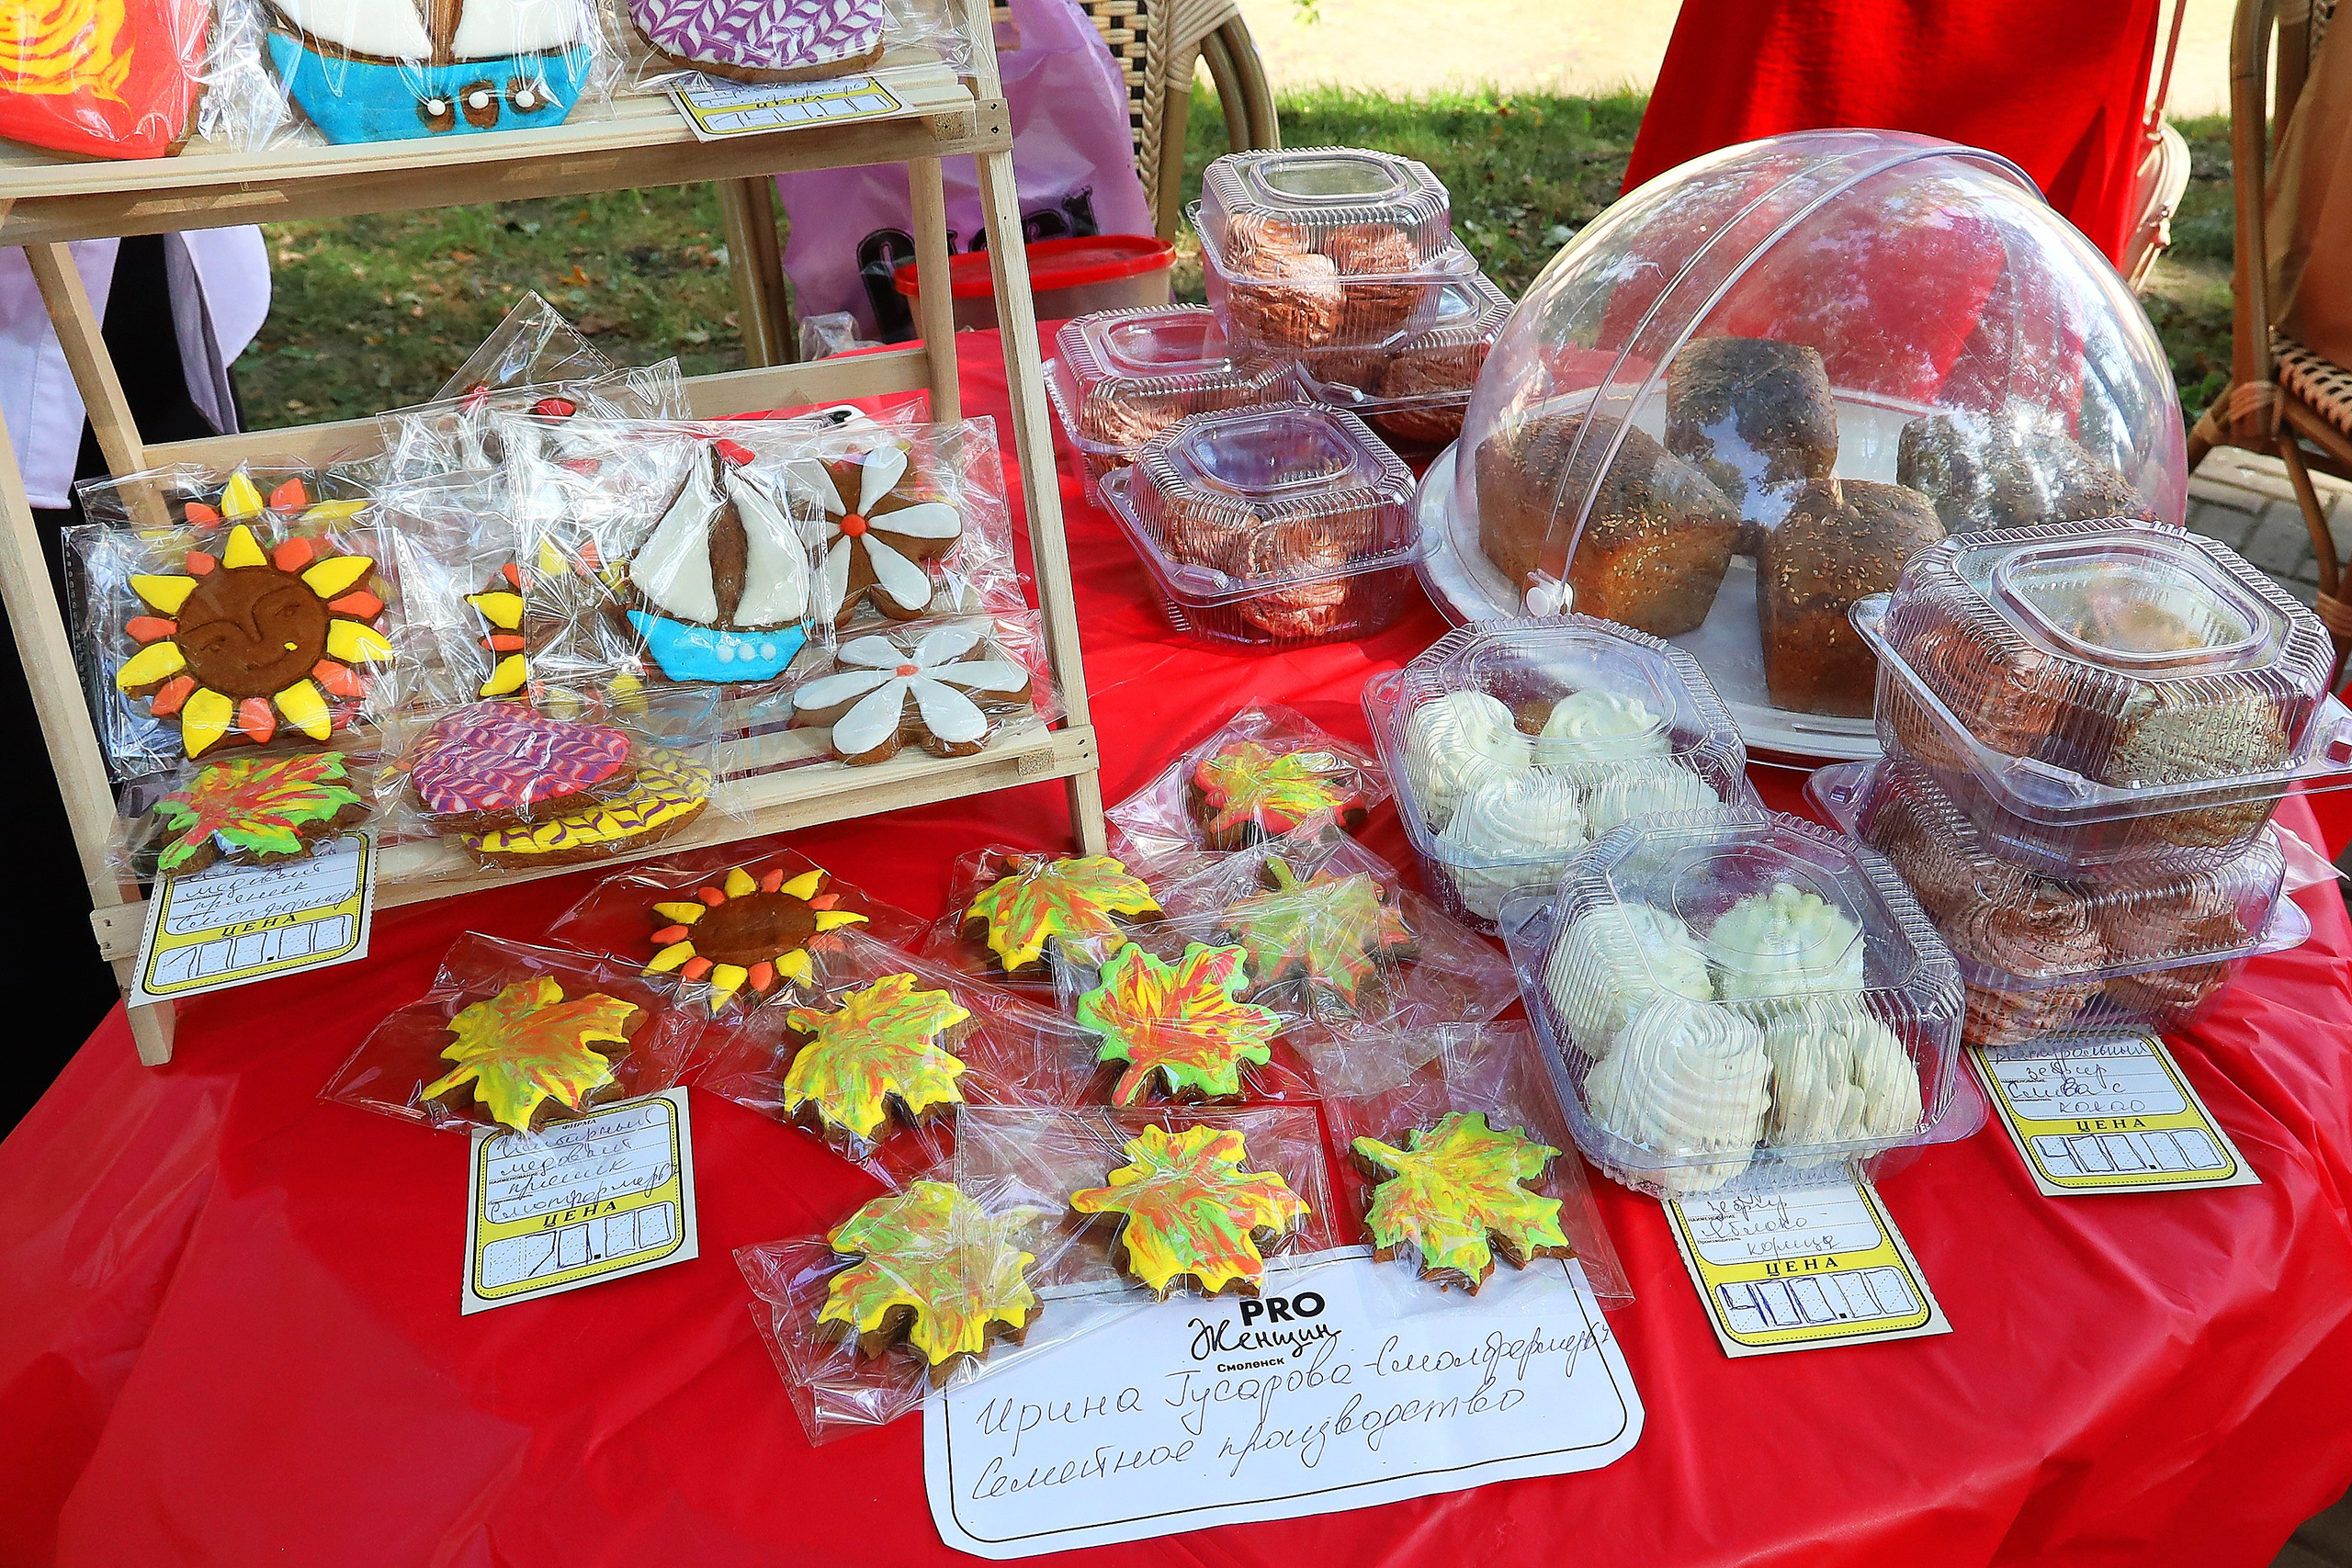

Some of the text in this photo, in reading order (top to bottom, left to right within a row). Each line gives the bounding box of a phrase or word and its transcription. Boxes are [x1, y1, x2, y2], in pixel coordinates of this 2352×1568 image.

[221, 914, 297, 937] ЦЕНА
[562, 1119, 597, 1130] ФИРМА
[2075, 1118, 2147, 1132] ЦЕНА
[2036, 1130, 2222, 1174] 400.00
[543, 1201, 616, 1228] ЦЕНА
[1766, 1257, 1838, 1277] ЦЕНА
[1239, 1292, 1326, 1326] PRO
[1719, 1269, 1914, 1327] 400.00
[1188, 1317, 1342, 1360] Женщин
[1216, 1357, 1285, 1372] Смоленск
[976, 1387, 1145, 1457] Ирина
[1164, 1335, 1353, 1436] Гусарова
[1218, 1376, 1525, 1478] производство
